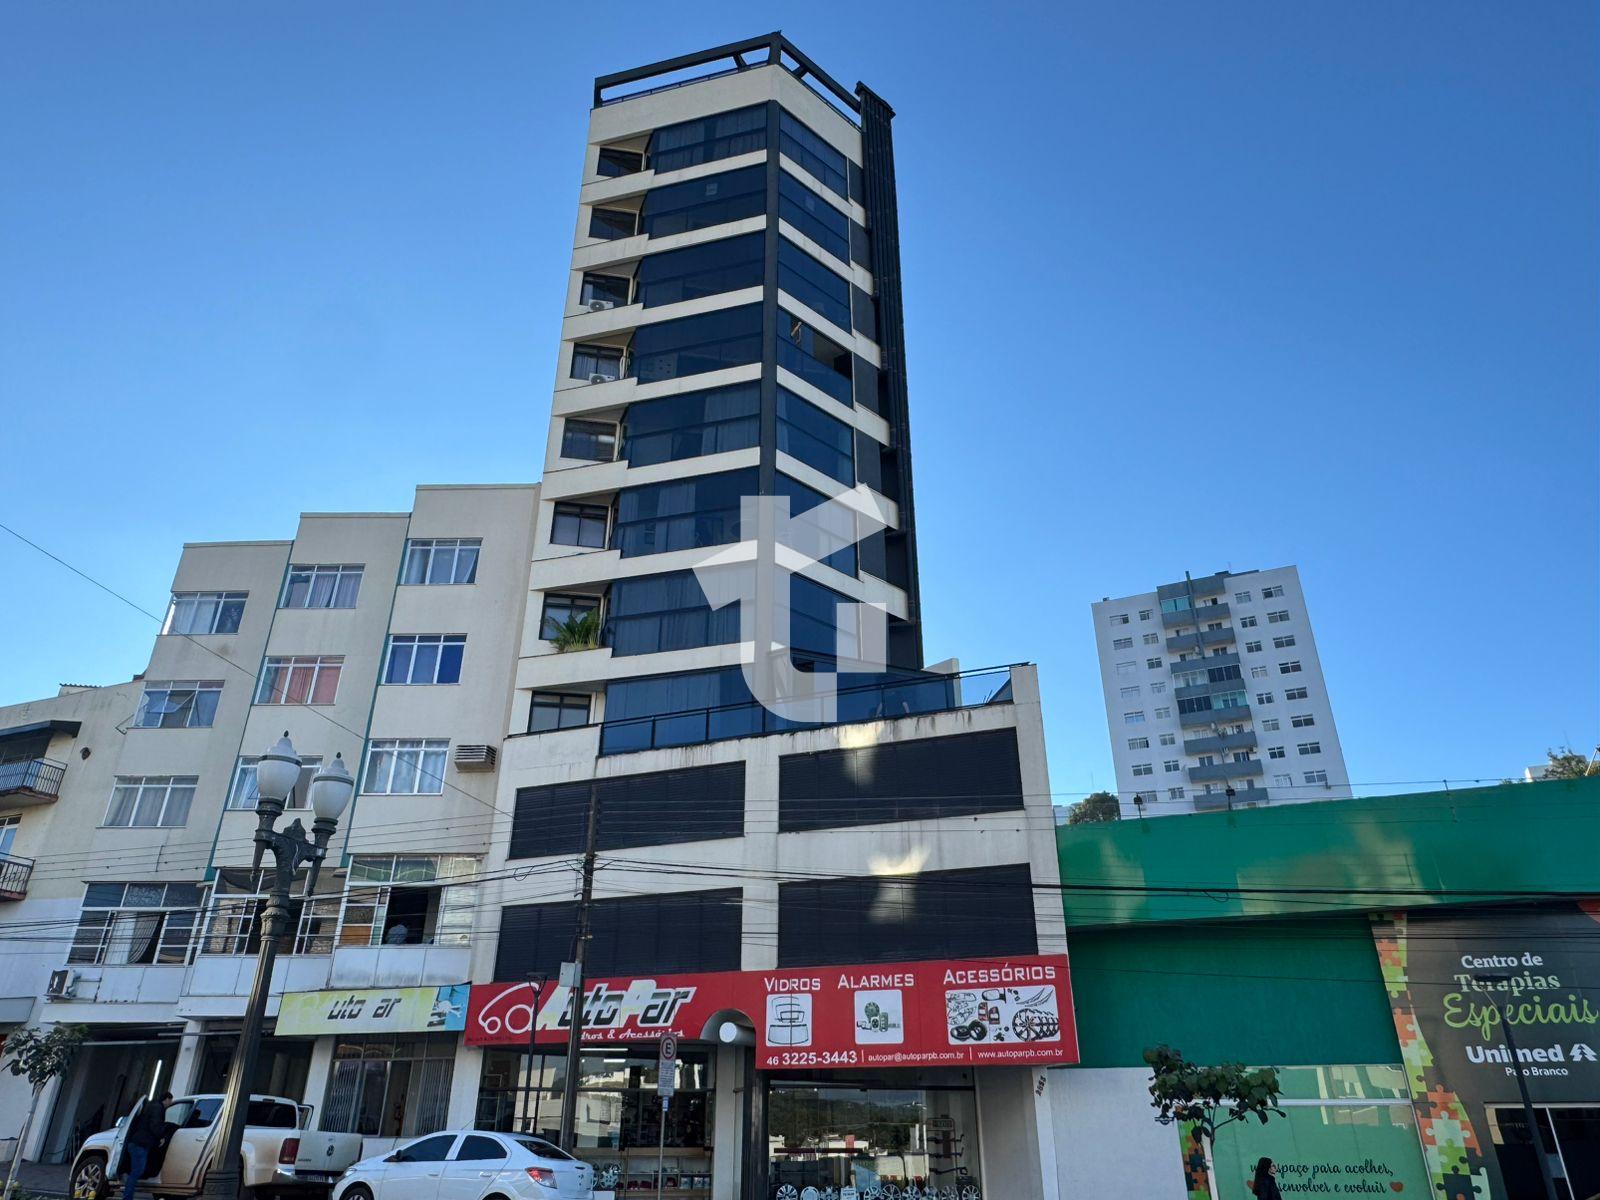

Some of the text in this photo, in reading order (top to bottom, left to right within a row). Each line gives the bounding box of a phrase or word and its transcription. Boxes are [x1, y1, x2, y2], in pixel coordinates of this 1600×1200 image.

[1461, 952, 1544, 969] Centro de
[764, 962, 1056, 992] VIDROS ALARMES ACESSÓRIOS
[1443, 994, 1599, 1041] Especiais
[767, 1048, 1063, 1066] 46 3225-3443 autopar@autoparpb.com.br www.autoparpb.com.br
[1465, 1044, 1565, 1064] Unimed
[1505, 1066, 1569, 1076] Pao Branco
[1276, 1163, 1309, 1179] spaço
[1312, 1163, 1342, 1179] para
[1345, 1159, 1394, 1177] acolher,
[1278, 1178, 1388, 1193] senvolver e evoluir
